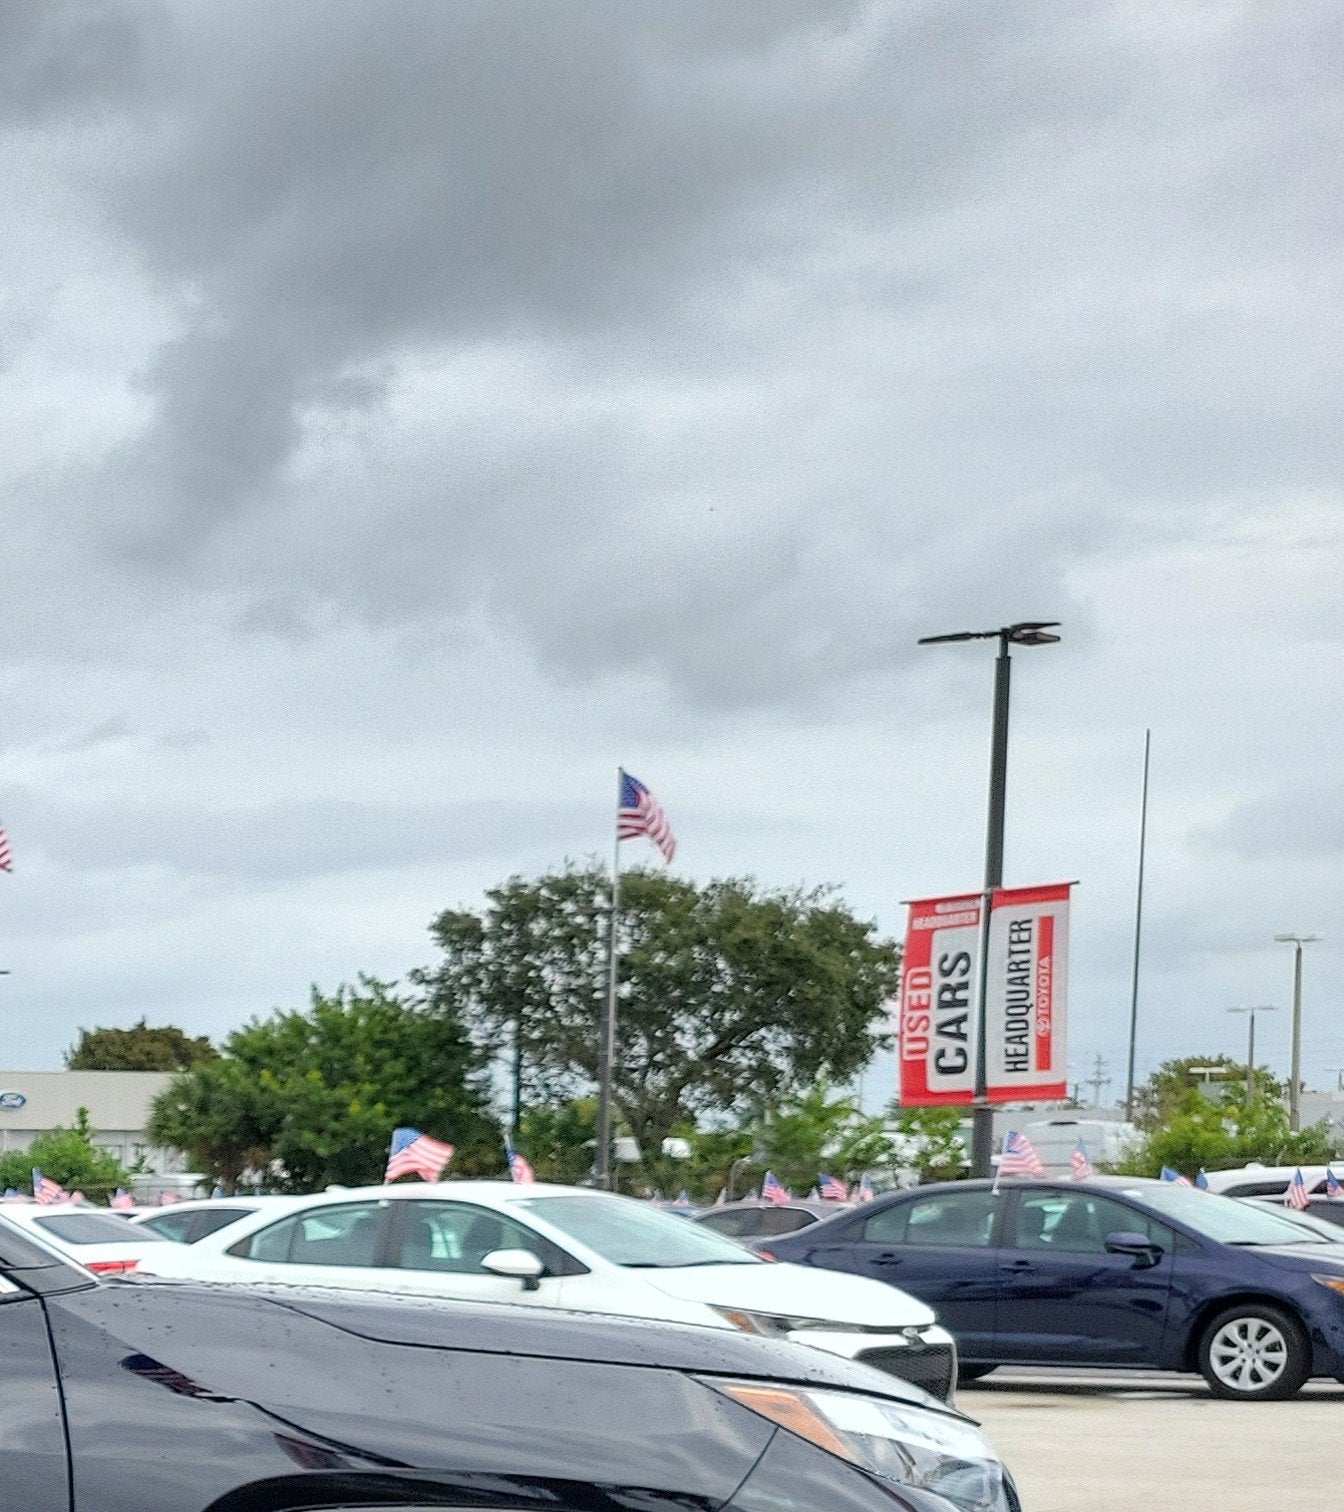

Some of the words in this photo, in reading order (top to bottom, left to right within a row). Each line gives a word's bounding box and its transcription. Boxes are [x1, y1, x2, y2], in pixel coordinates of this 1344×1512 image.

[905, 968, 932, 1056] USED
[935, 950, 971, 1076] CARS
[1005, 917, 1033, 1074] HEADQUARTER
